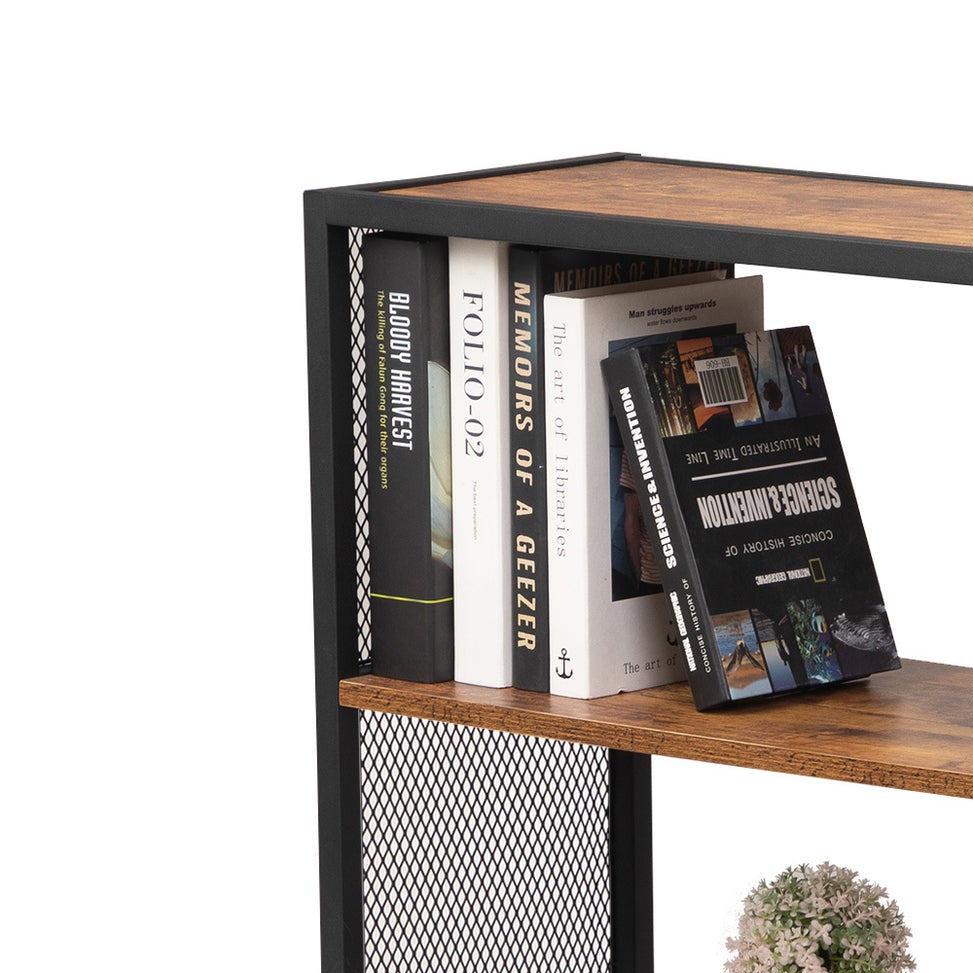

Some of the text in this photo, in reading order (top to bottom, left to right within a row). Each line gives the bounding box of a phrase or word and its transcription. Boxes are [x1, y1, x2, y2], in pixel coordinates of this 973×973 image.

[554, 261, 622, 293] MEMOIRS
[628, 299, 717, 319] Man struggles upwards
[376, 290, 388, 489] The killing of Falun Gong for their organs
[389, 292, 412, 451] BLOODY HARVEST
[462, 289, 485, 458] FOLIO-02
[514, 282, 536, 651] MEMOIRS OF A GEEZER
[553, 323, 570, 557] The art of libraries
[725, 529, 834, 557] CONCISE HISTORY OF
[623, 653, 678, 675] The art of
[681, 578, 711, 673] CONCISE HISTORY OF
